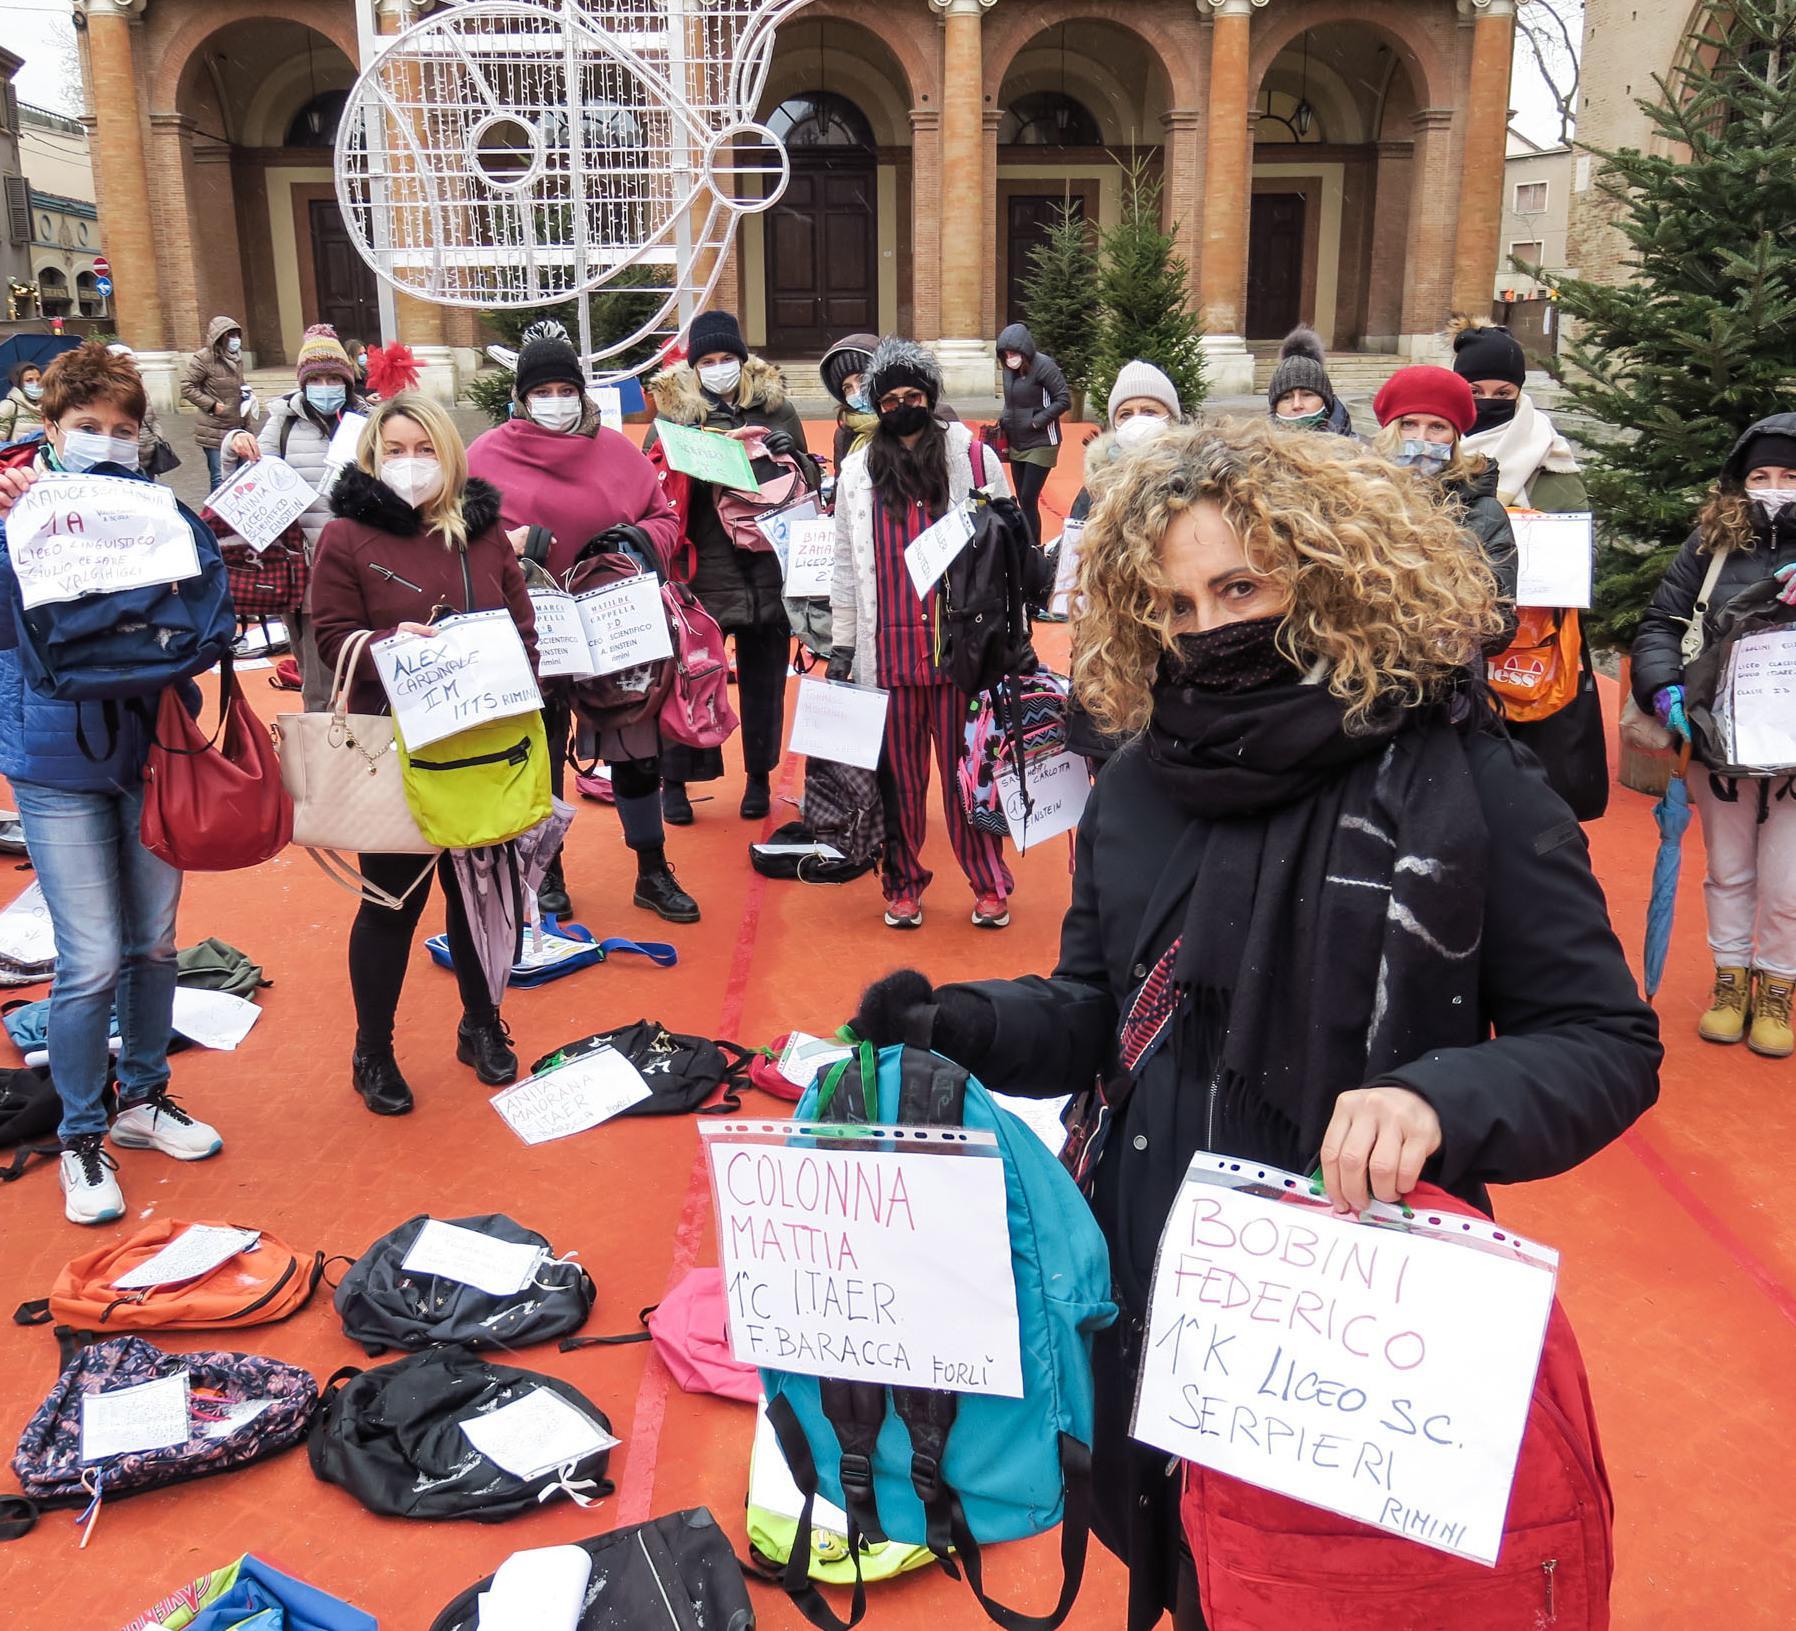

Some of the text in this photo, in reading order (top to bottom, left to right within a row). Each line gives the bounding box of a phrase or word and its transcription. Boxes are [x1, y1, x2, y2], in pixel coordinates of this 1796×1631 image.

[243, 506, 268, 534] LICEO
[590, 604, 636, 624] CAPPELLA
[610, 623, 653, 641] SCIENTIFICO
[393, 644, 448, 682] ALEX
[609, 639, 638, 653] EINSTEIN
[396, 650, 480, 696] CARDINALE
[454, 692, 498, 720] ITTS
[1034, 762, 1070, 784] CARLOTTA
[506, 1080, 554, 1113] ANITA
[512, 1074, 593, 1124] MAIORANA
[728, 1152, 915, 1230] COLONNA
[730, 1215, 858, 1272] MATTIA
[1191, 1198, 1410, 1304] BOBINI
[1175, 1253, 1426, 1370] FEDERICO
[1257, 1346, 1367, 1412] LICEO
[1380, 1399, 1464, 1450] SC.
[1169, 1384, 1394, 1492] SERPIERI
